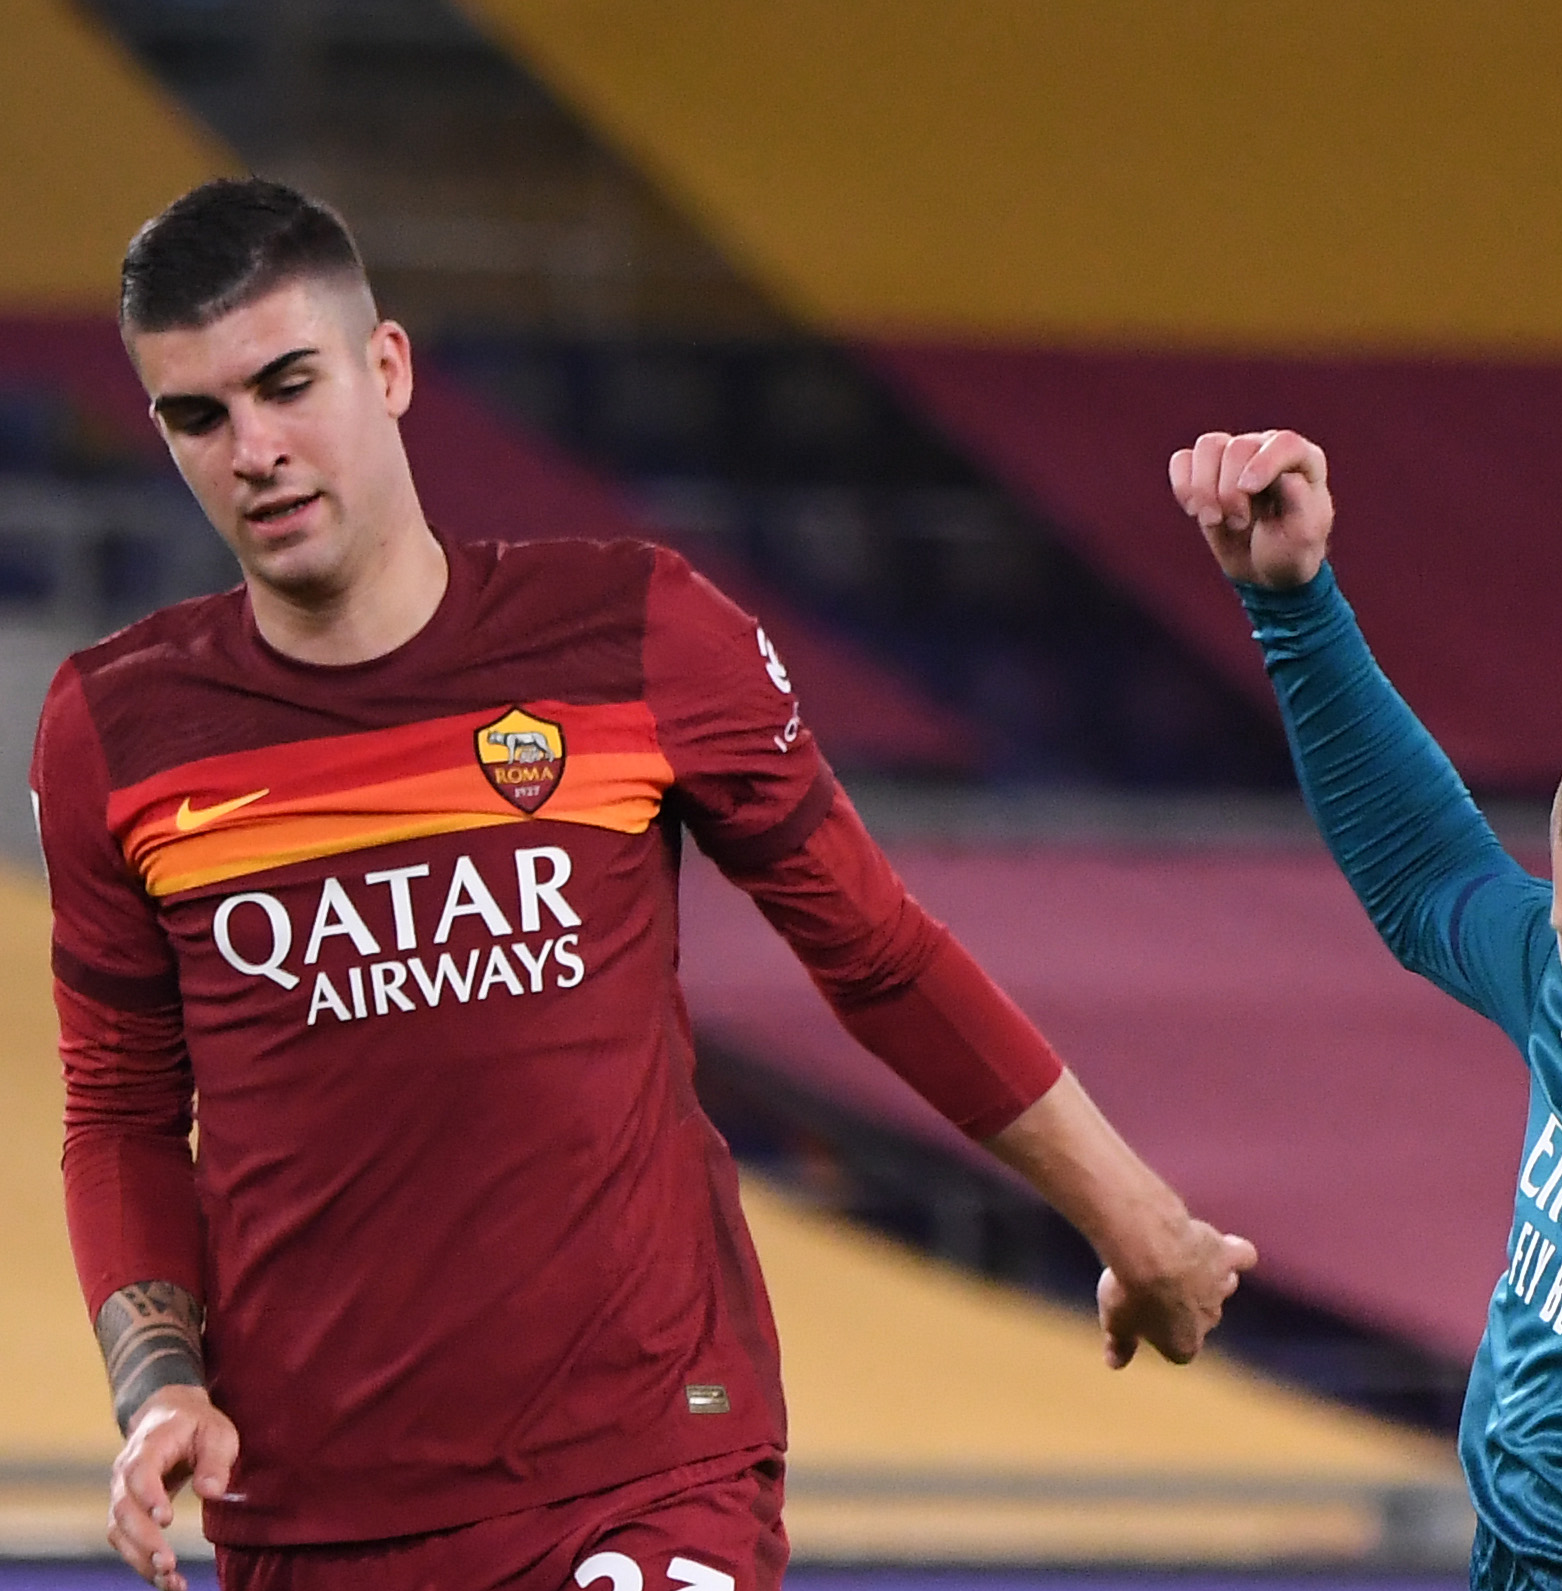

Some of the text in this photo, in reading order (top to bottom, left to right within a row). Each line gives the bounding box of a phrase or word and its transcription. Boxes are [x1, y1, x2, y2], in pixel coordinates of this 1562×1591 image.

[494, 766, 554, 784] ROMA
[212, 846, 583, 991] QATAR
[306, 933, 586, 1026] AIRWAYS
[1508, 1221, 1556, 1305] FLY
